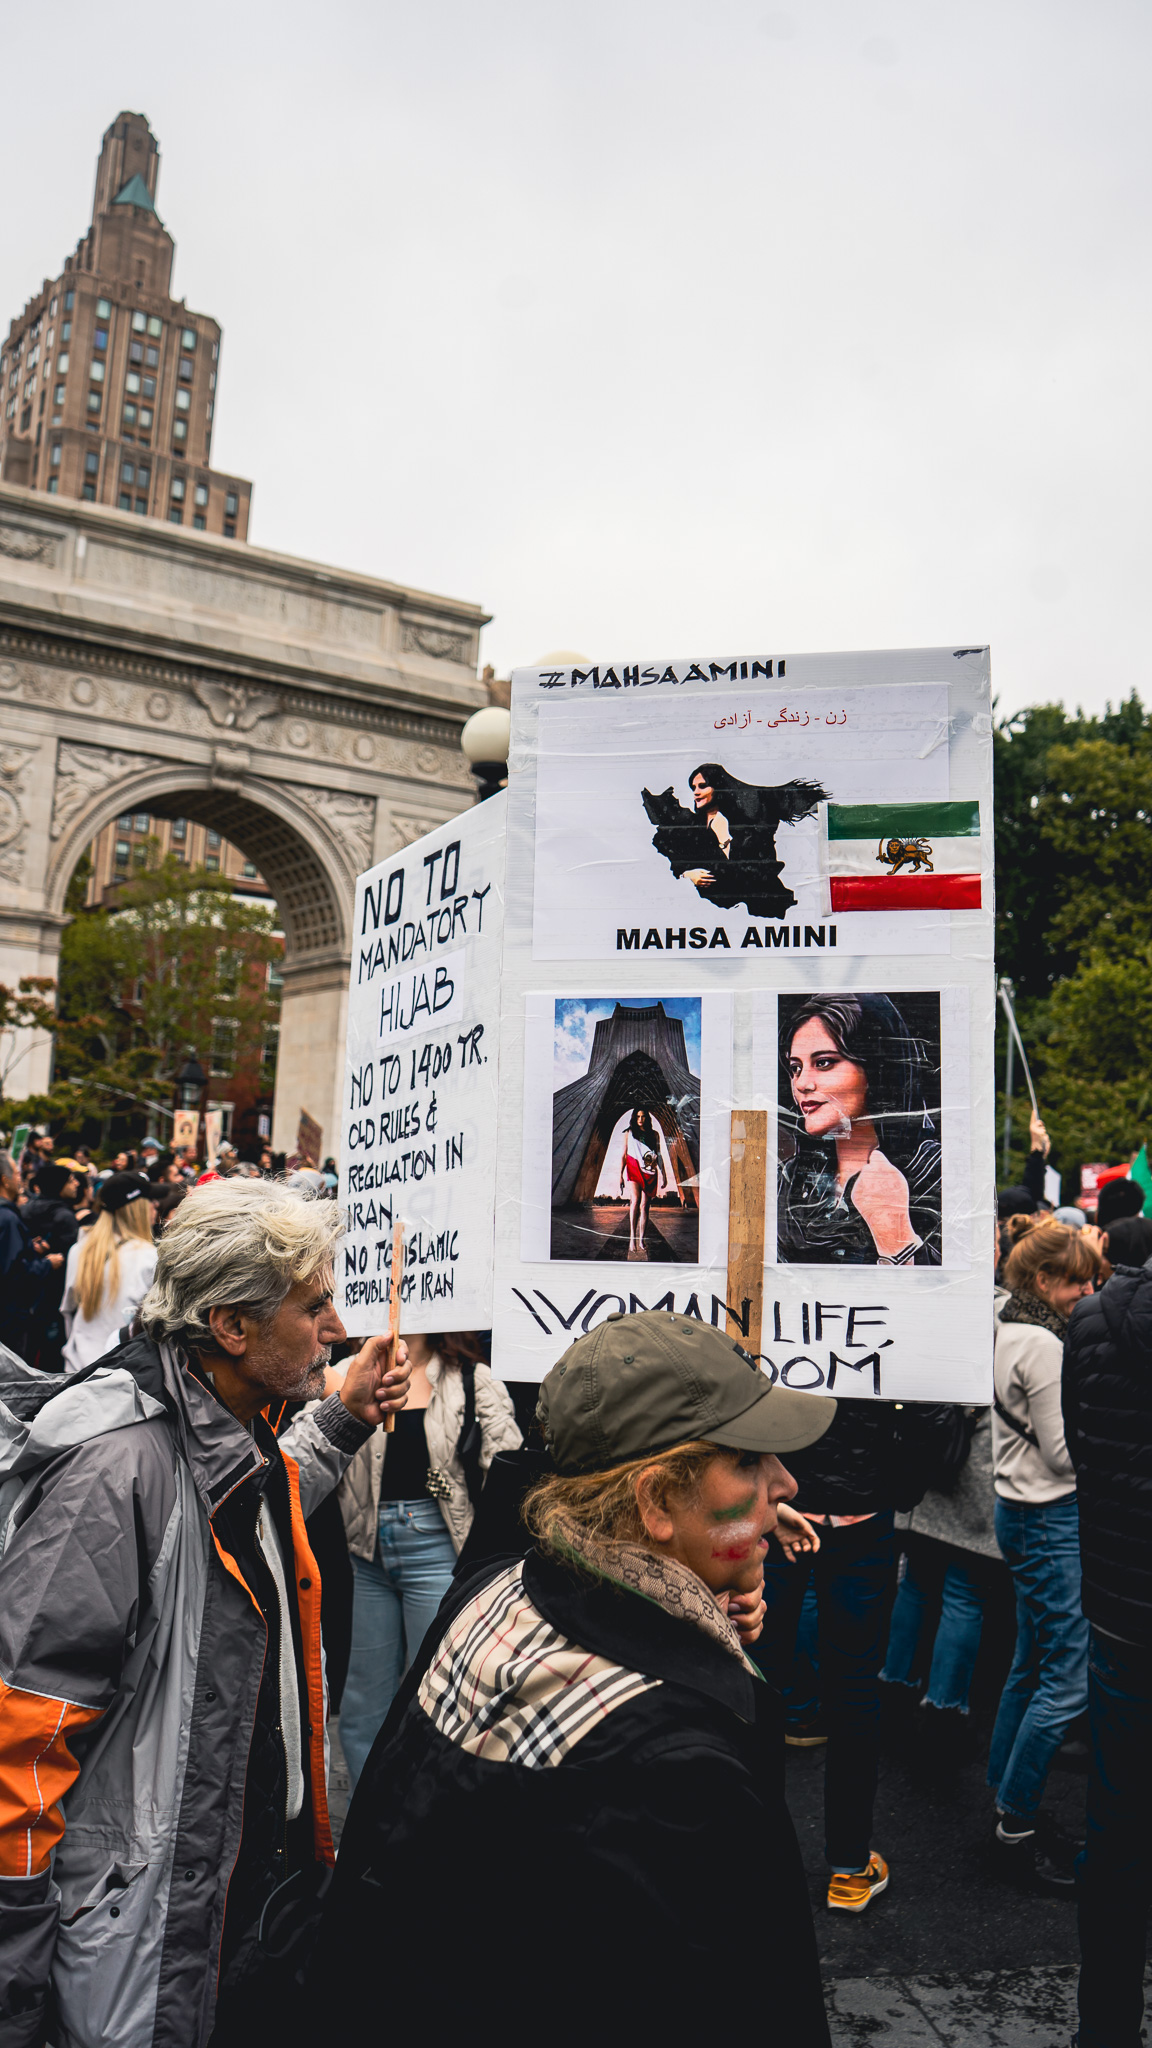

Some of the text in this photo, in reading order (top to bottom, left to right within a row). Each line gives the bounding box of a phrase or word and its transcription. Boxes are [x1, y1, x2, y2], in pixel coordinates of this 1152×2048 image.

[538, 659, 787, 690] #MAHSAAMINI
[713, 709, 752, 729] آزادی
[767, 707, 810, 728] زندگی
[825, 709, 847, 725] زن
[361, 840, 461, 935] NO TO
[358, 882, 491, 985] MANDATORY
[616, 924, 838, 950] MAHSA AMINI
[379, 966, 454, 1038] HIJAB
[350, 1062, 374, 1110] NO
[379, 1054, 401, 1100] TO
[410, 1042, 452, 1091] 1400
[348, 1118, 376, 1151] OLD
[379, 1101, 421, 1146] RULES
[425, 1090, 438, 1134] &
[348, 1132, 464, 1195] REGULATION IN
[347, 1193, 399, 1233] IRAN.
[344, 1245, 369, 1277] NO
[404, 1229, 460, 1269] ISLAMIC
[421, 1267, 454, 1304] IRAN
[773, 1301, 895, 1350] LIFE,
